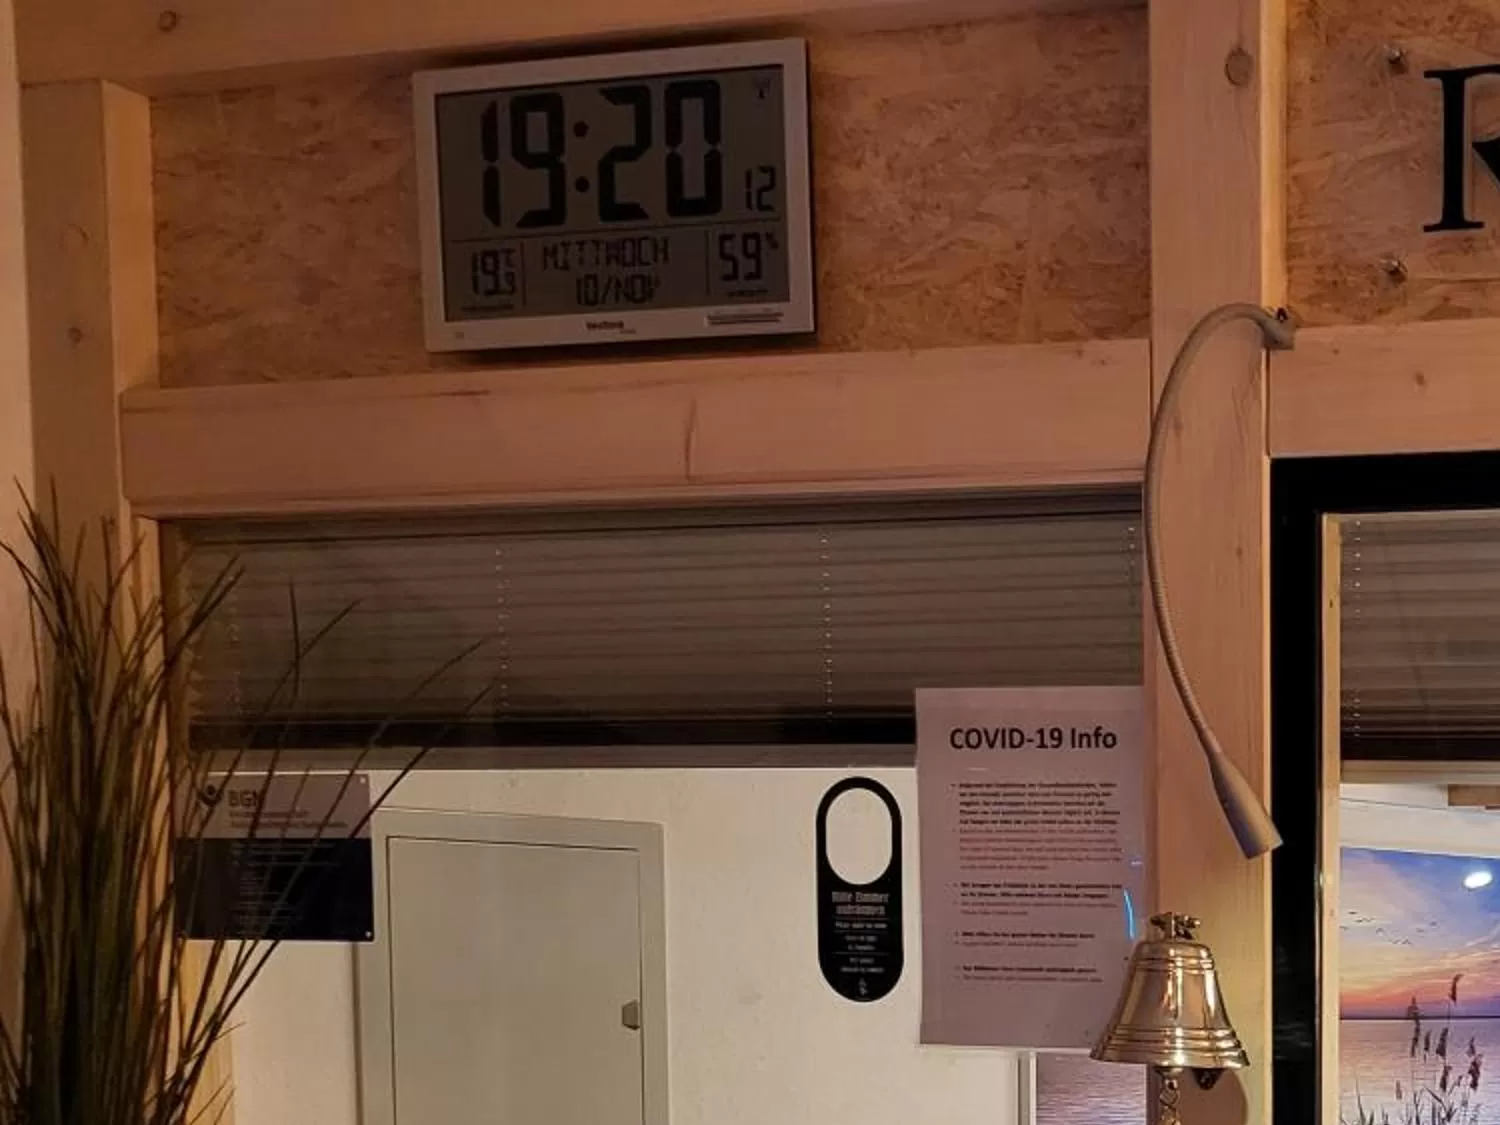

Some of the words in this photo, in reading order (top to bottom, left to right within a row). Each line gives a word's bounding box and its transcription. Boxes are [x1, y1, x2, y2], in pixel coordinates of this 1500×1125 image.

[481, 79, 722, 228] 19:20
[744, 165, 776, 212] 12
[542, 236, 669, 272] MITTWOCH
[949, 727, 1063, 750] COVID-19
[1070, 726, 1117, 750] Info
